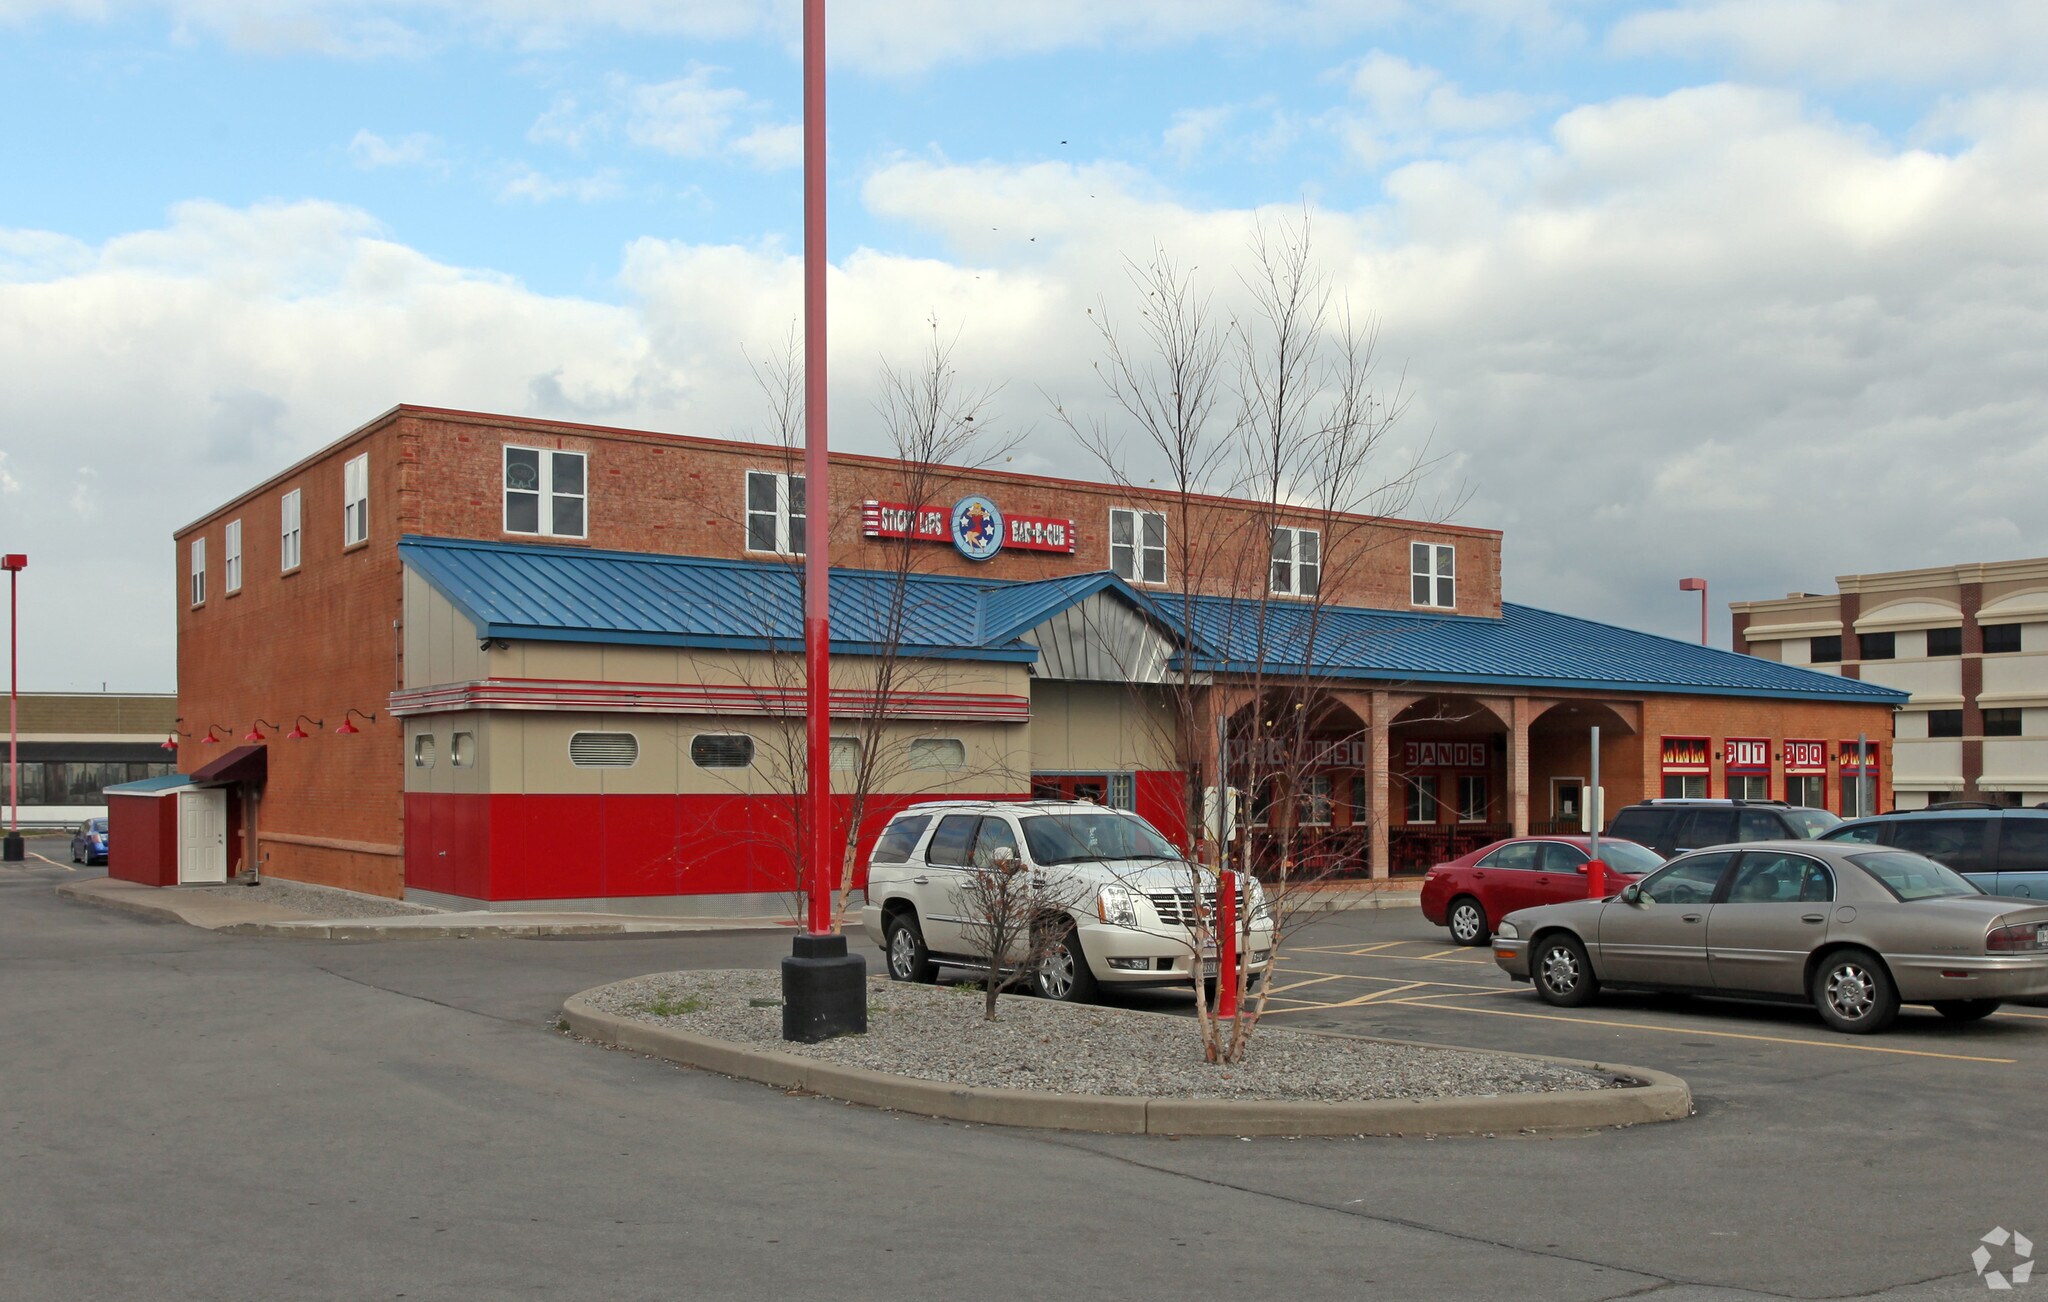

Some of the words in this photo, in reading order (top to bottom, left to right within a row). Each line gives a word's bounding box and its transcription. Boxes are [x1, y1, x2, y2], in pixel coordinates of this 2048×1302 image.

[1011, 520, 1066, 546] BAR-B-QUE
[1405, 742, 1486, 766] BANDS
[1784, 744, 1822, 765] BBQ
